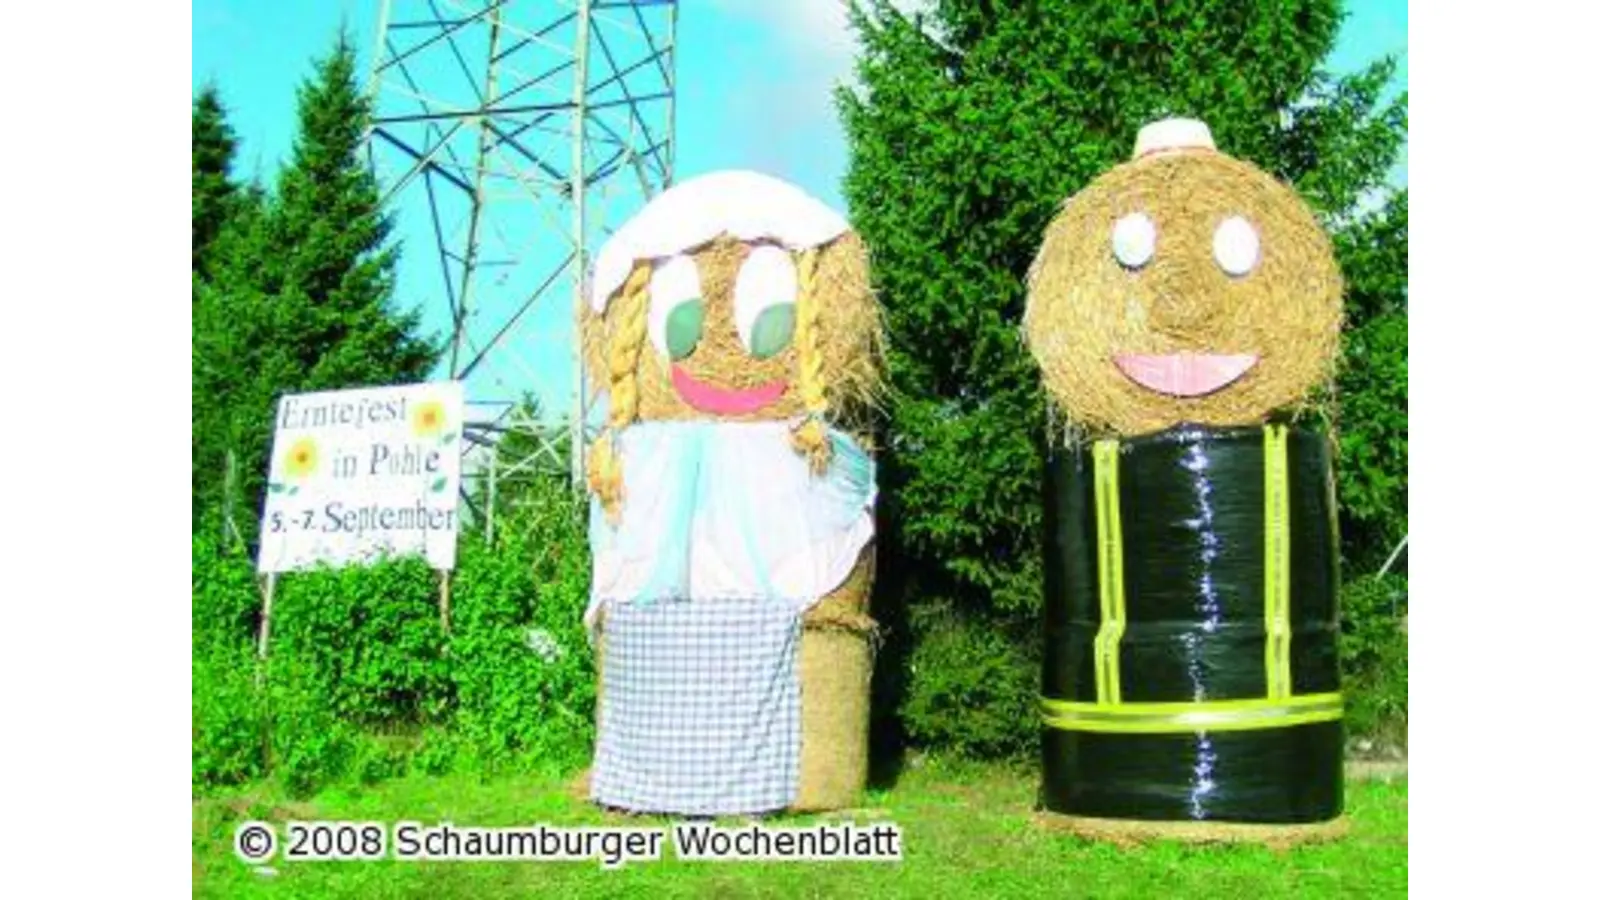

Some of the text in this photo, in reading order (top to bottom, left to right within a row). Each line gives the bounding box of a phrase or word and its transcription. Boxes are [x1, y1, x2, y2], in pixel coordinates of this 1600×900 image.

[282, 397, 407, 429] Erntefest
[333, 443, 440, 478] in Pohle
[322, 499, 456, 538] September
